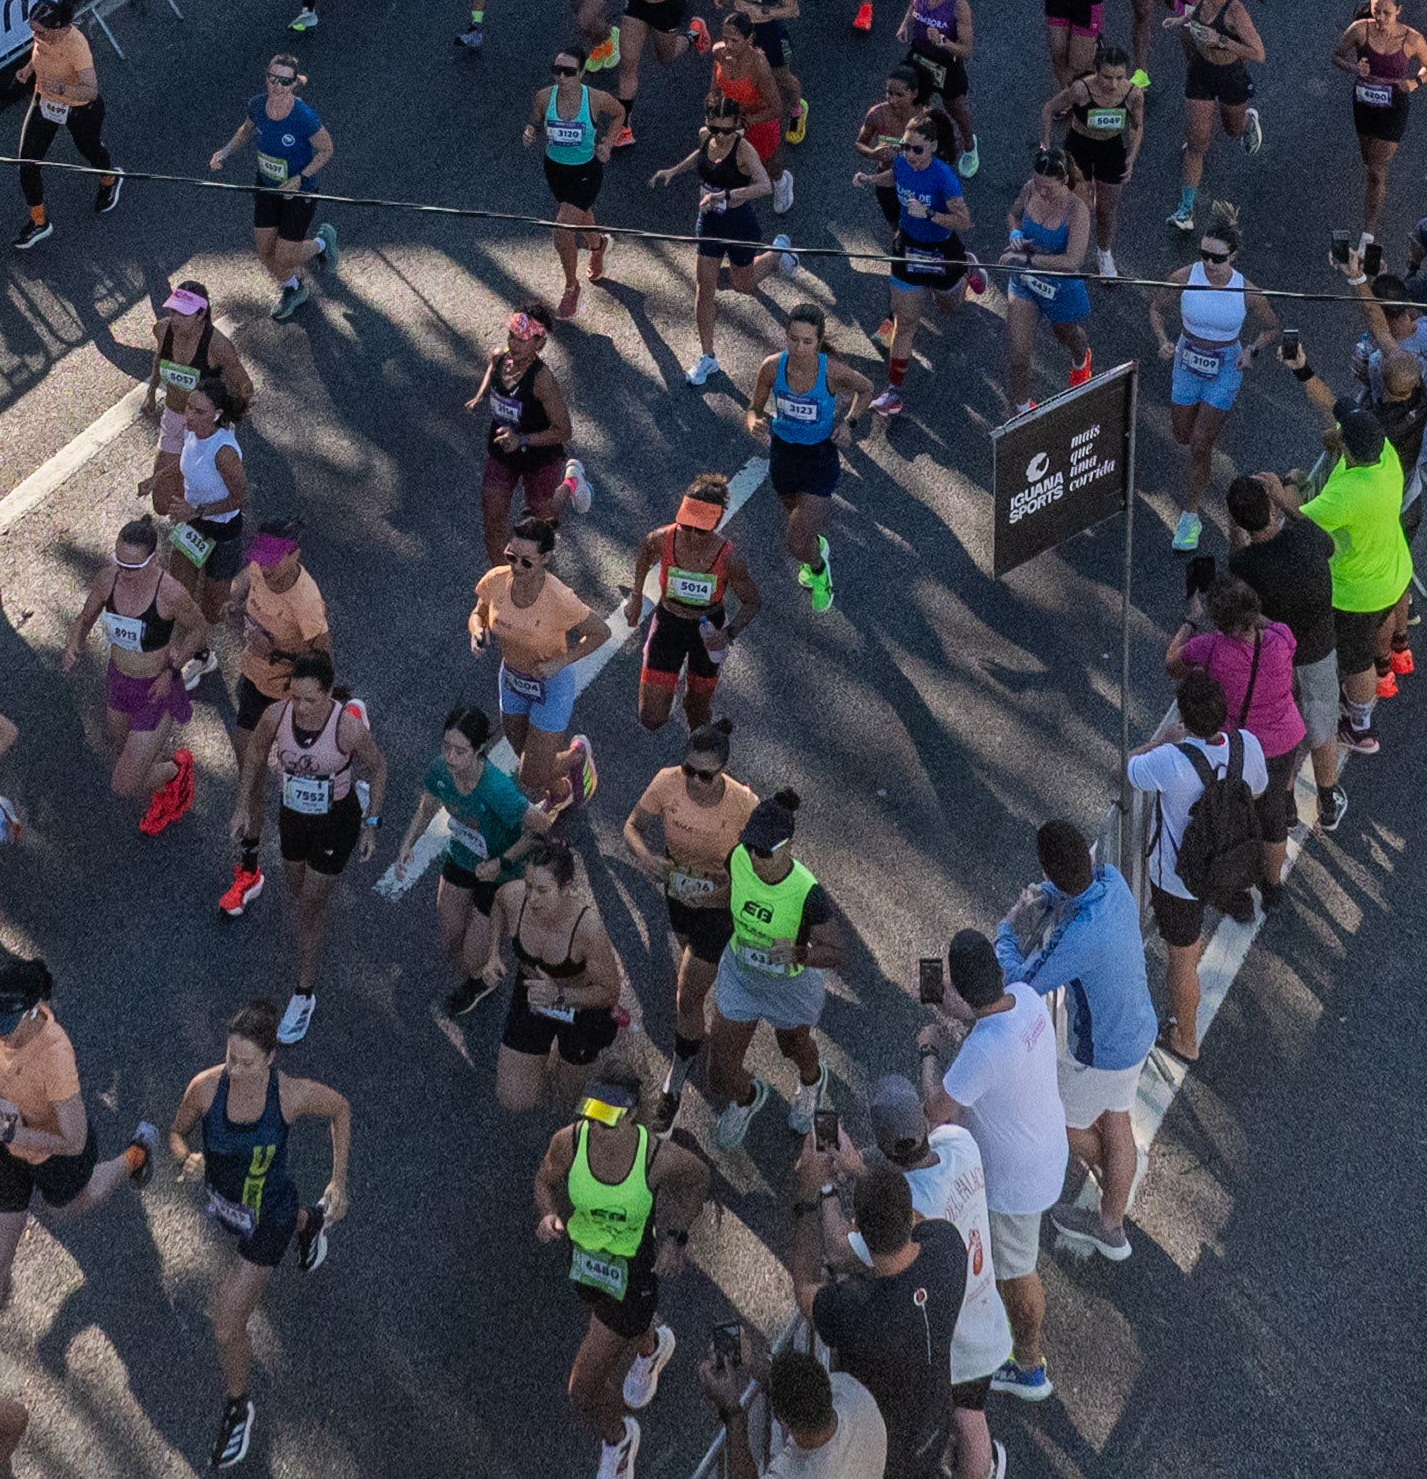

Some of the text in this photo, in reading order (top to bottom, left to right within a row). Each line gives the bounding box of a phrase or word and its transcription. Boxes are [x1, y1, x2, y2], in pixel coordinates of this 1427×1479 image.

[557, 130, 580, 139] 3120
[1192, 354, 1217, 369] 3109
[789, 404, 814, 416] 3123
[1070, 423, 1100, 449] mais
[1070, 446, 1093, 466] que
[1069, 455, 1098, 477] uma
[1069, 459, 1115, 492] corrida
[1009, 470, 1064, 511] IGUANA
[1008, 486, 1063, 525] SPORTS
[680, 581, 709, 596] 5014
[114, 625, 138, 643] 8913
[295, 789, 326, 803] 7552
